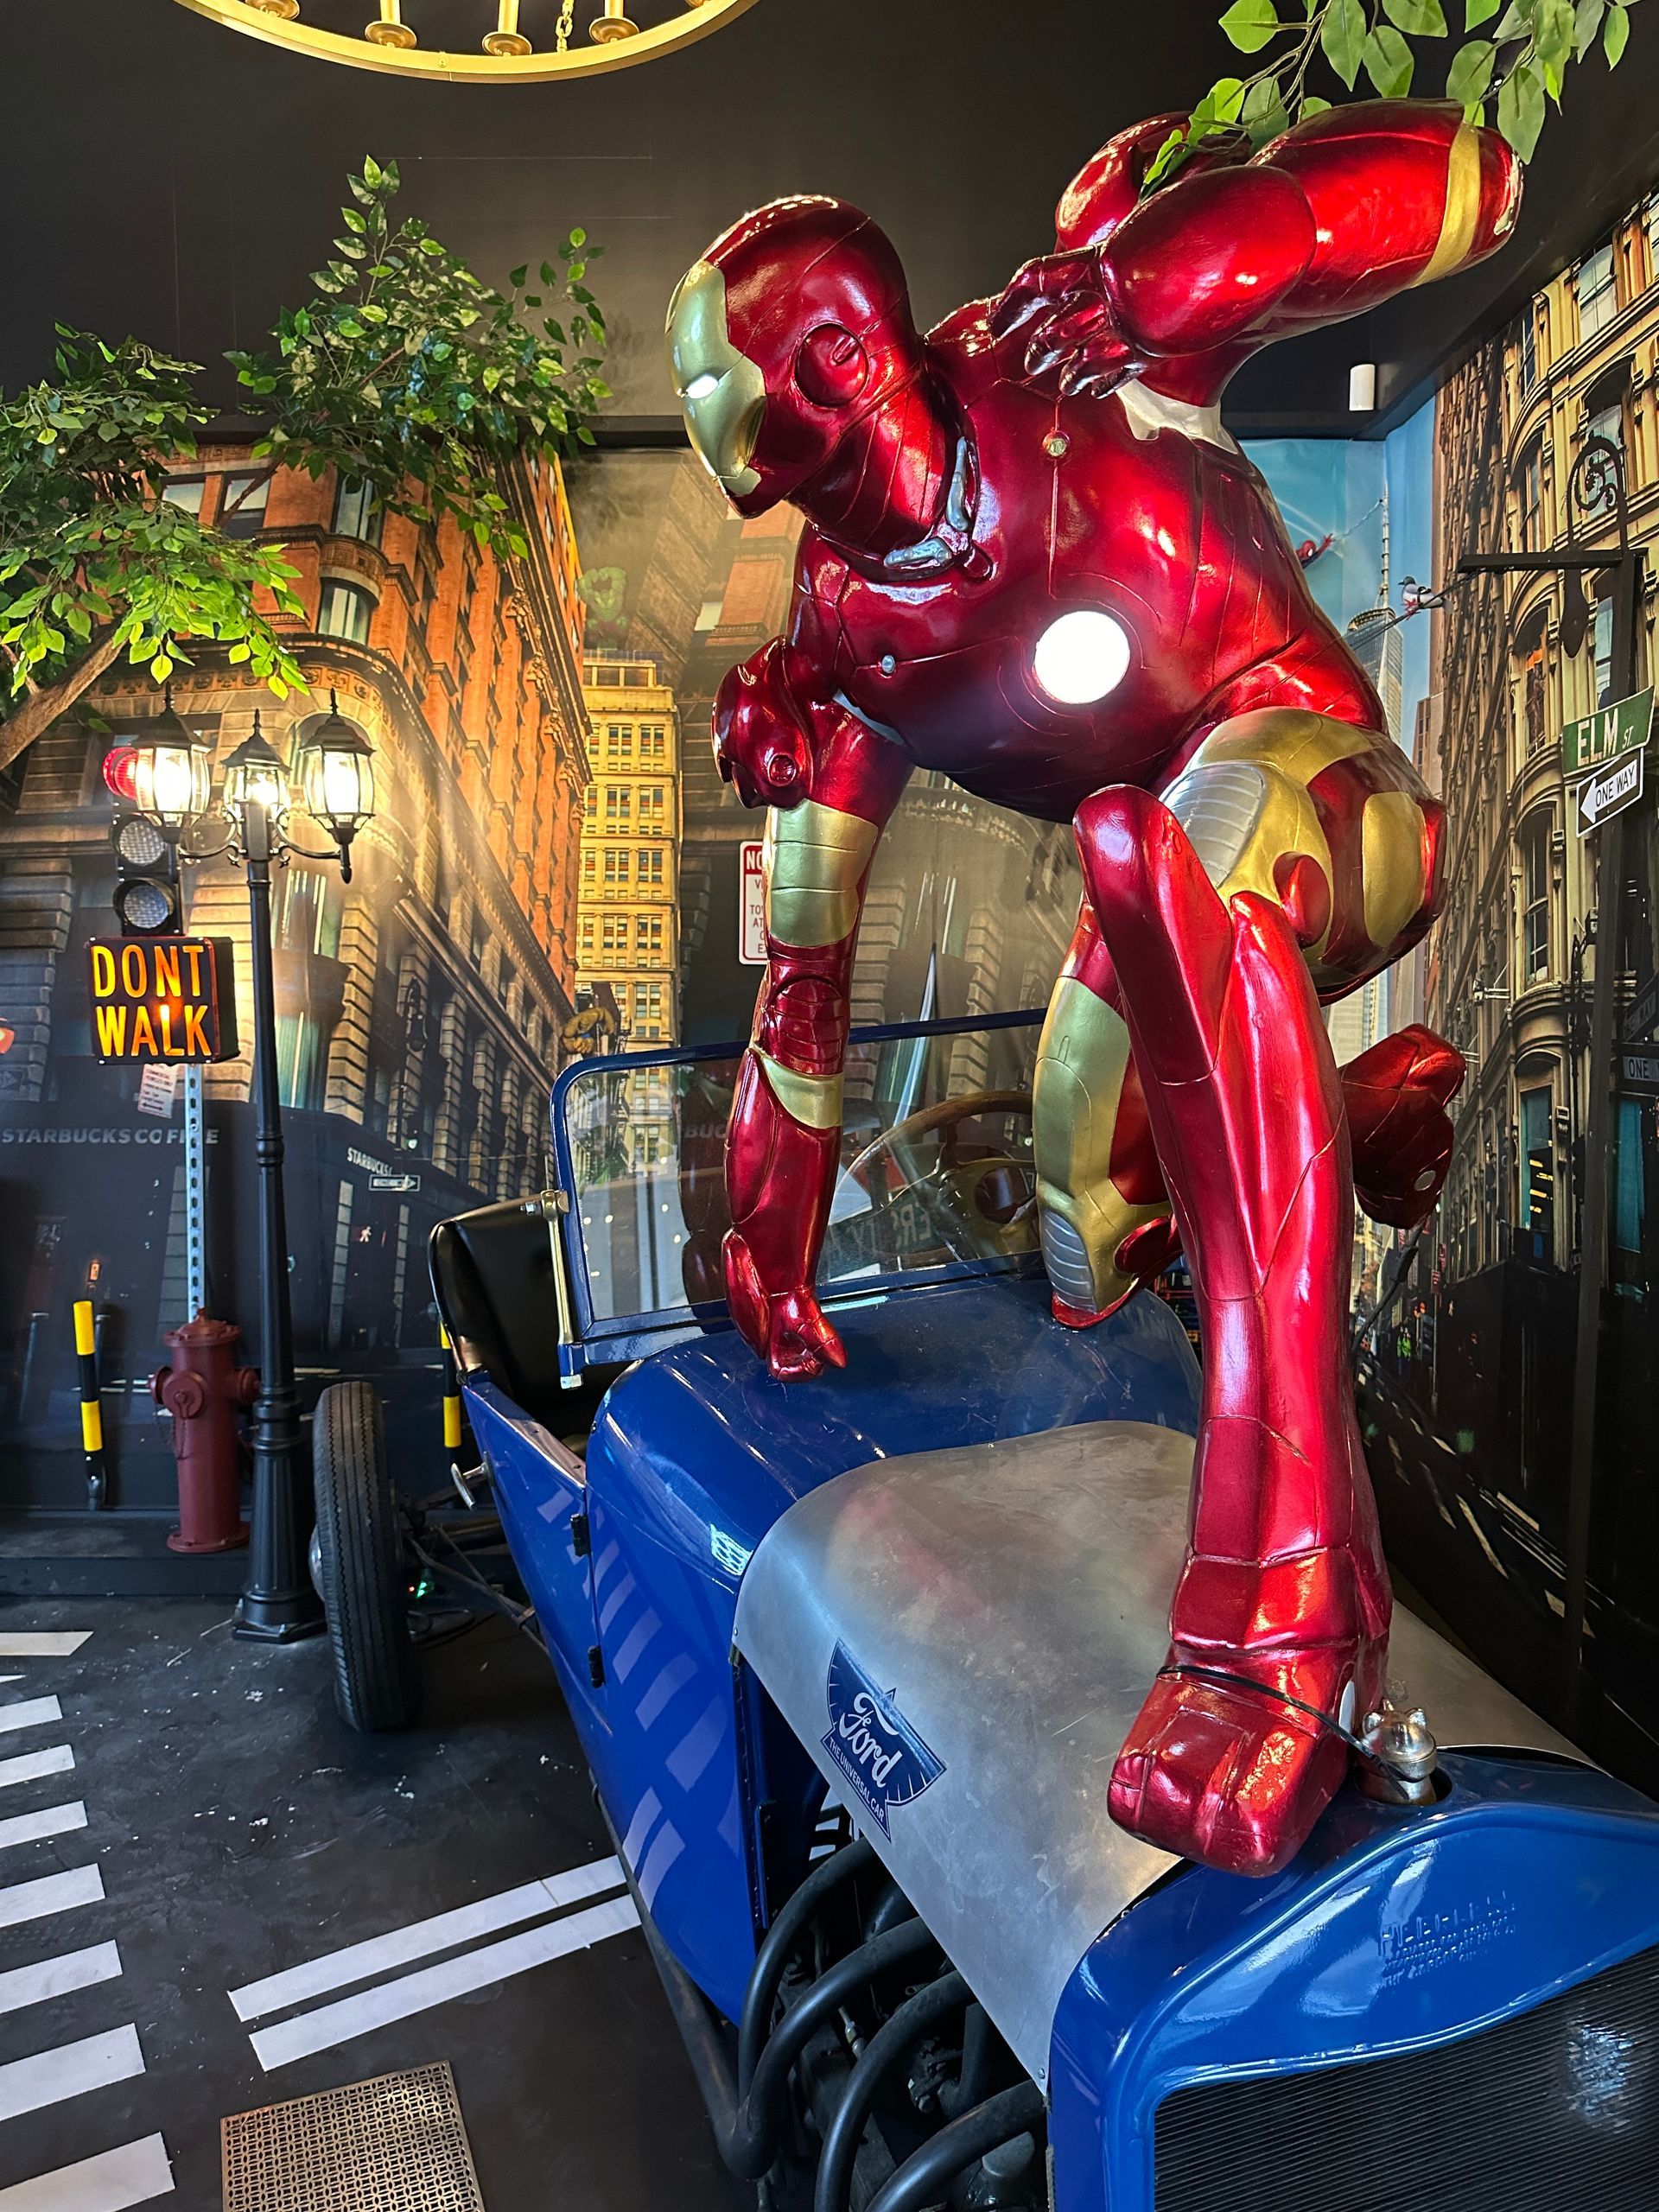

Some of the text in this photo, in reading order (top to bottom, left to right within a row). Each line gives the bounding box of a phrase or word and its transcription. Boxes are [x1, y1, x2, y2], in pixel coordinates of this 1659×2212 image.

[1577, 708, 1618, 767] ELM
[1595, 765, 1636, 807] ONE WAY
[92, 944, 204, 998] DONT
[95, 1004, 212, 1057] WALK
[1629, 1058, 1649, 1079] ONE
[2, 1128, 219, 1145] STARBUCKS COFE
[839, 1692, 903, 1789] Ford
[829, 1736, 885, 1822] THE UNIVERSAL CAR
